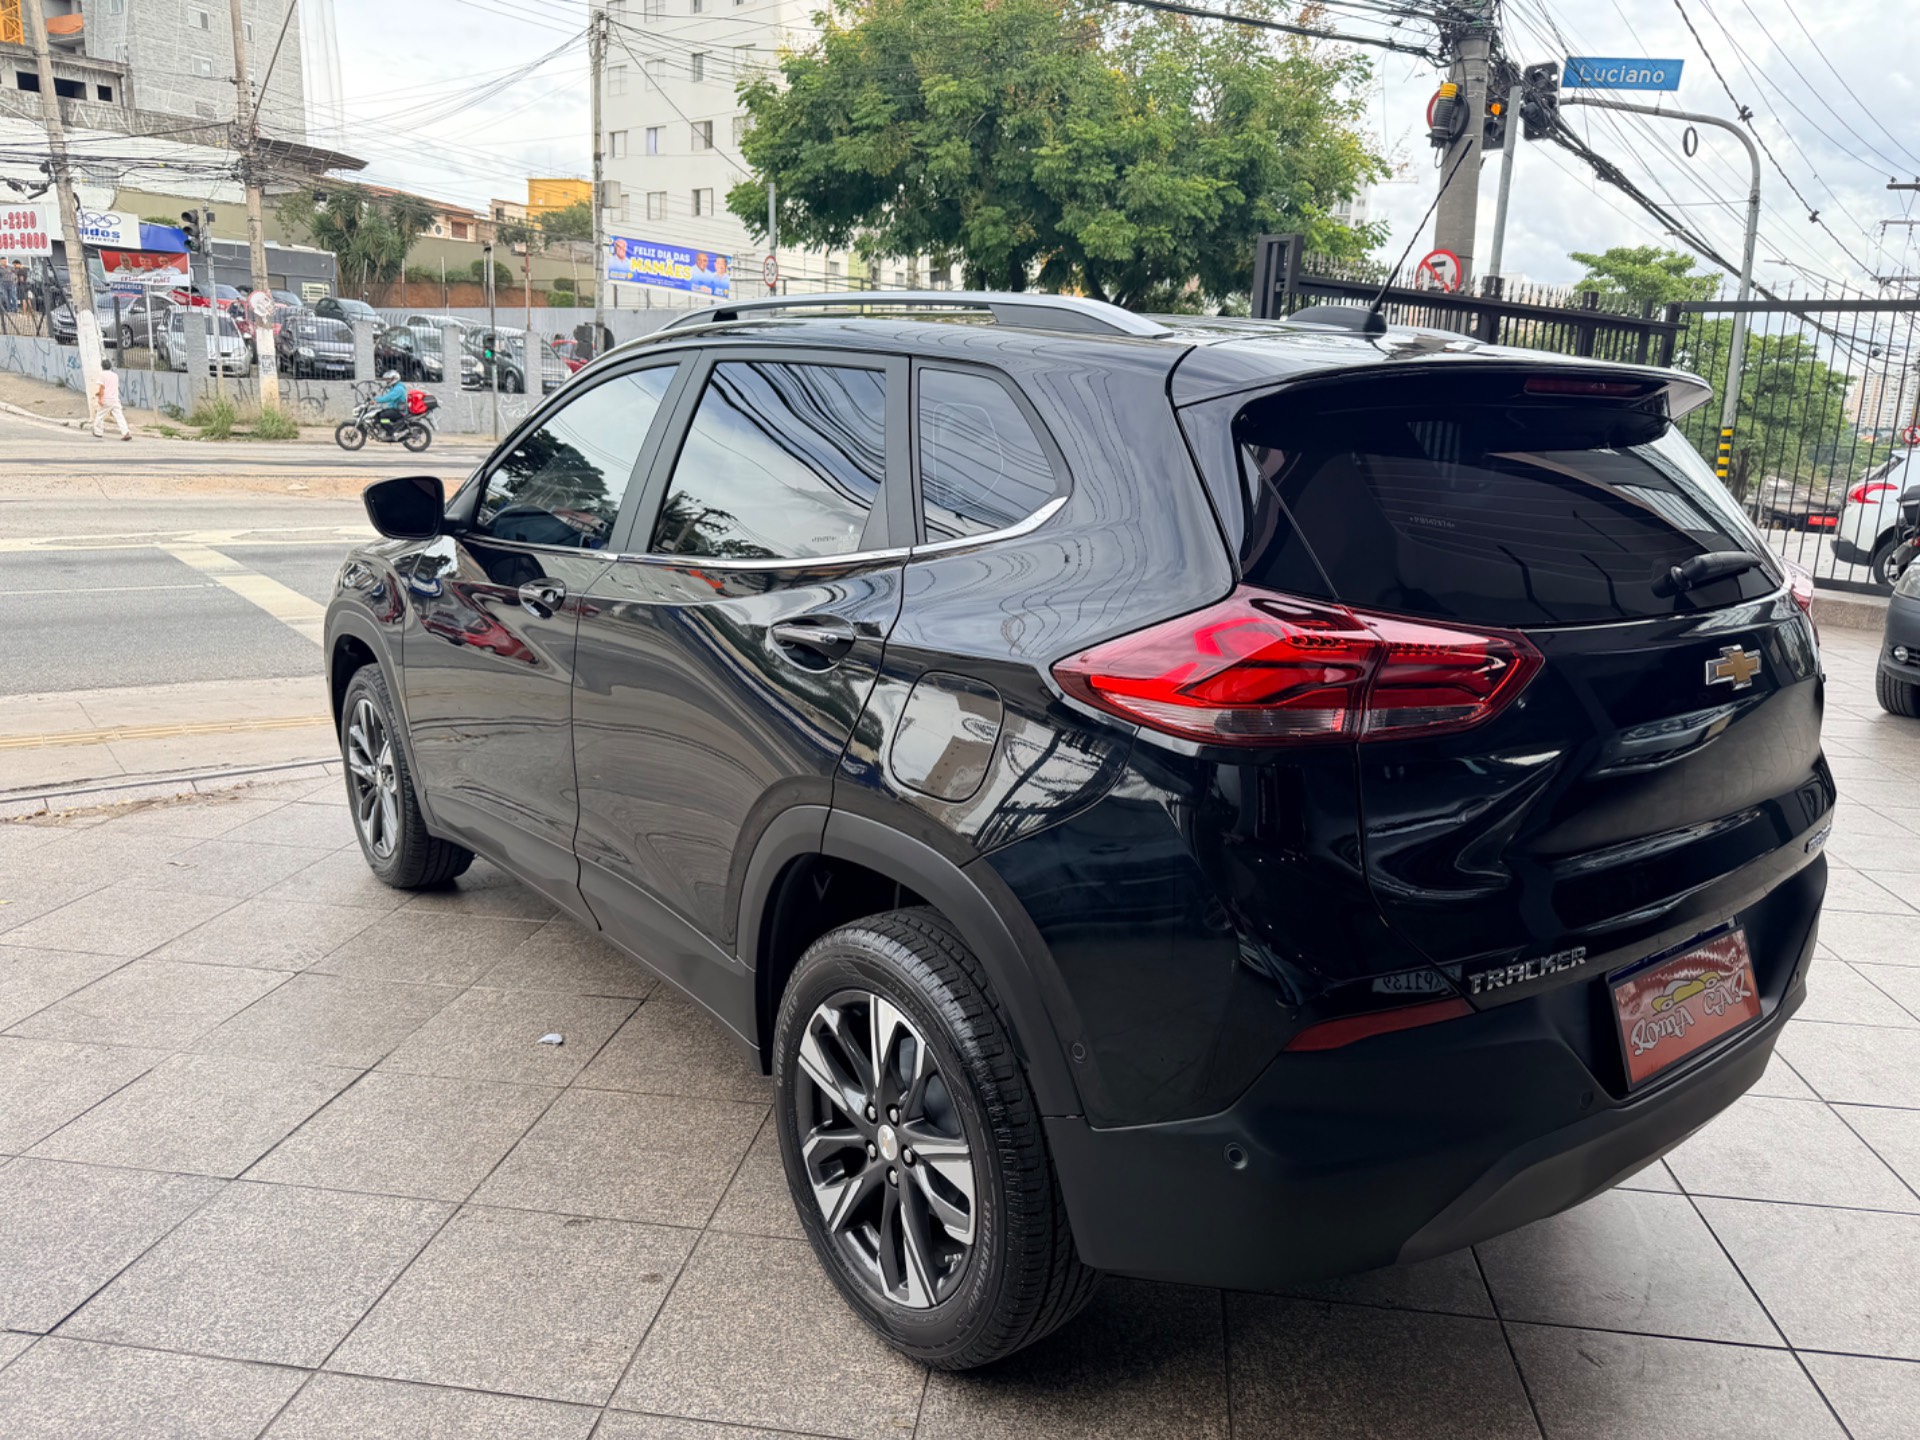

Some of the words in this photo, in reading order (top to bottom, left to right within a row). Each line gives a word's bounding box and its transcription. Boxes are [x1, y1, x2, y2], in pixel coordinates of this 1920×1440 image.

[1579, 64, 1665, 83] Luciano
[633, 245, 656, 259] FELIZ
[657, 250, 672, 261] DIA
[673, 251, 691, 263] DAS
[630, 256, 692, 281] MAMÃES
[1467, 946, 1587, 994] TRACKER
